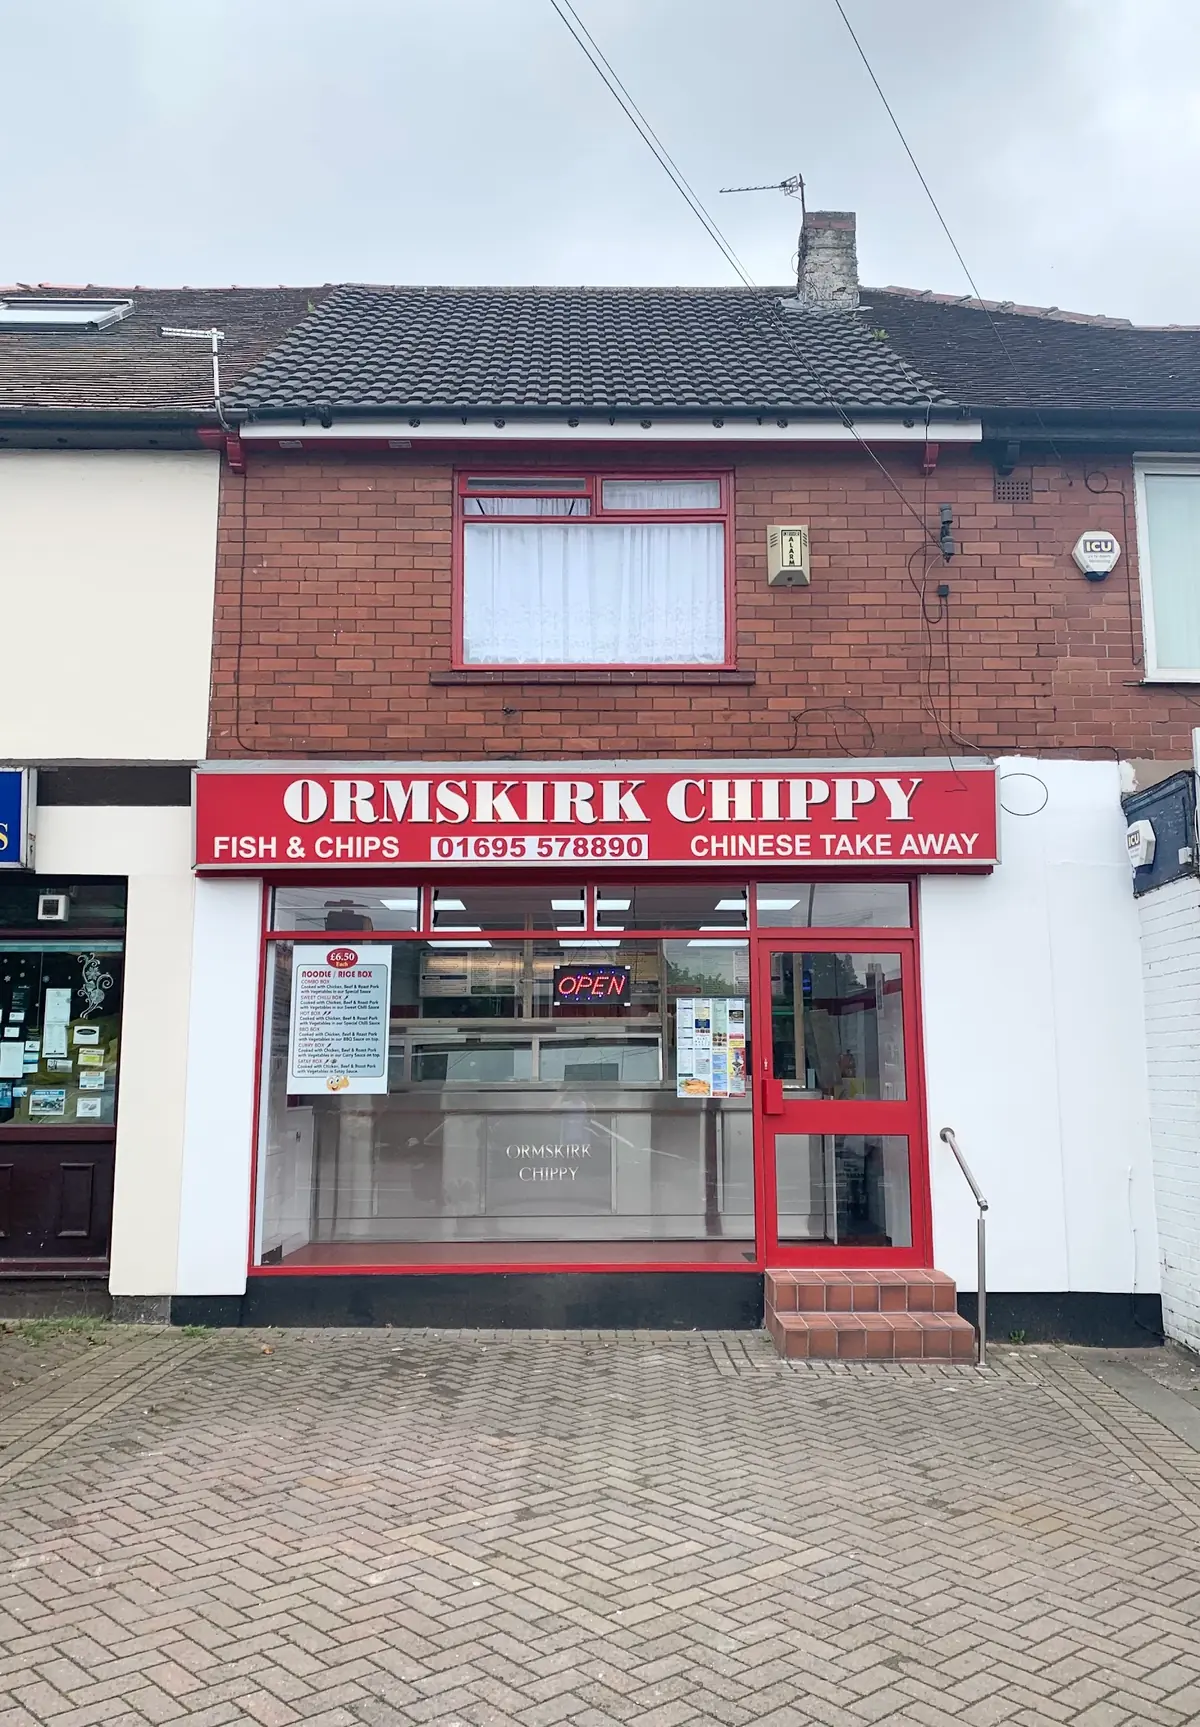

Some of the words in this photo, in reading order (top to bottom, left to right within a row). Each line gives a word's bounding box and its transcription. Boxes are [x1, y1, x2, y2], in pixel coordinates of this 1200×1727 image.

[1086, 541, 1112, 552] ICU
[283, 778, 650, 824] ORMSKIRK
[666, 778, 923, 822] CHIPPY
[214, 836, 277, 859] FISH
[286, 836, 306, 859] &
[314, 836, 400, 859] CHIPS
[437, 837, 526, 858] 01695
[536, 836, 644, 858] 578890
[690, 834, 812, 858] CHINESE
[820, 834, 893, 856] TAKE
[900, 833, 980, 856] AWAY
[1128, 832, 1140, 847] ICU
[330, 952, 354, 961] £6.50
[558, 975, 626, 995] OPEN
[506, 1144, 592, 1159] ORMSKIRK
[519, 1166, 579, 1181] CHIPPY
